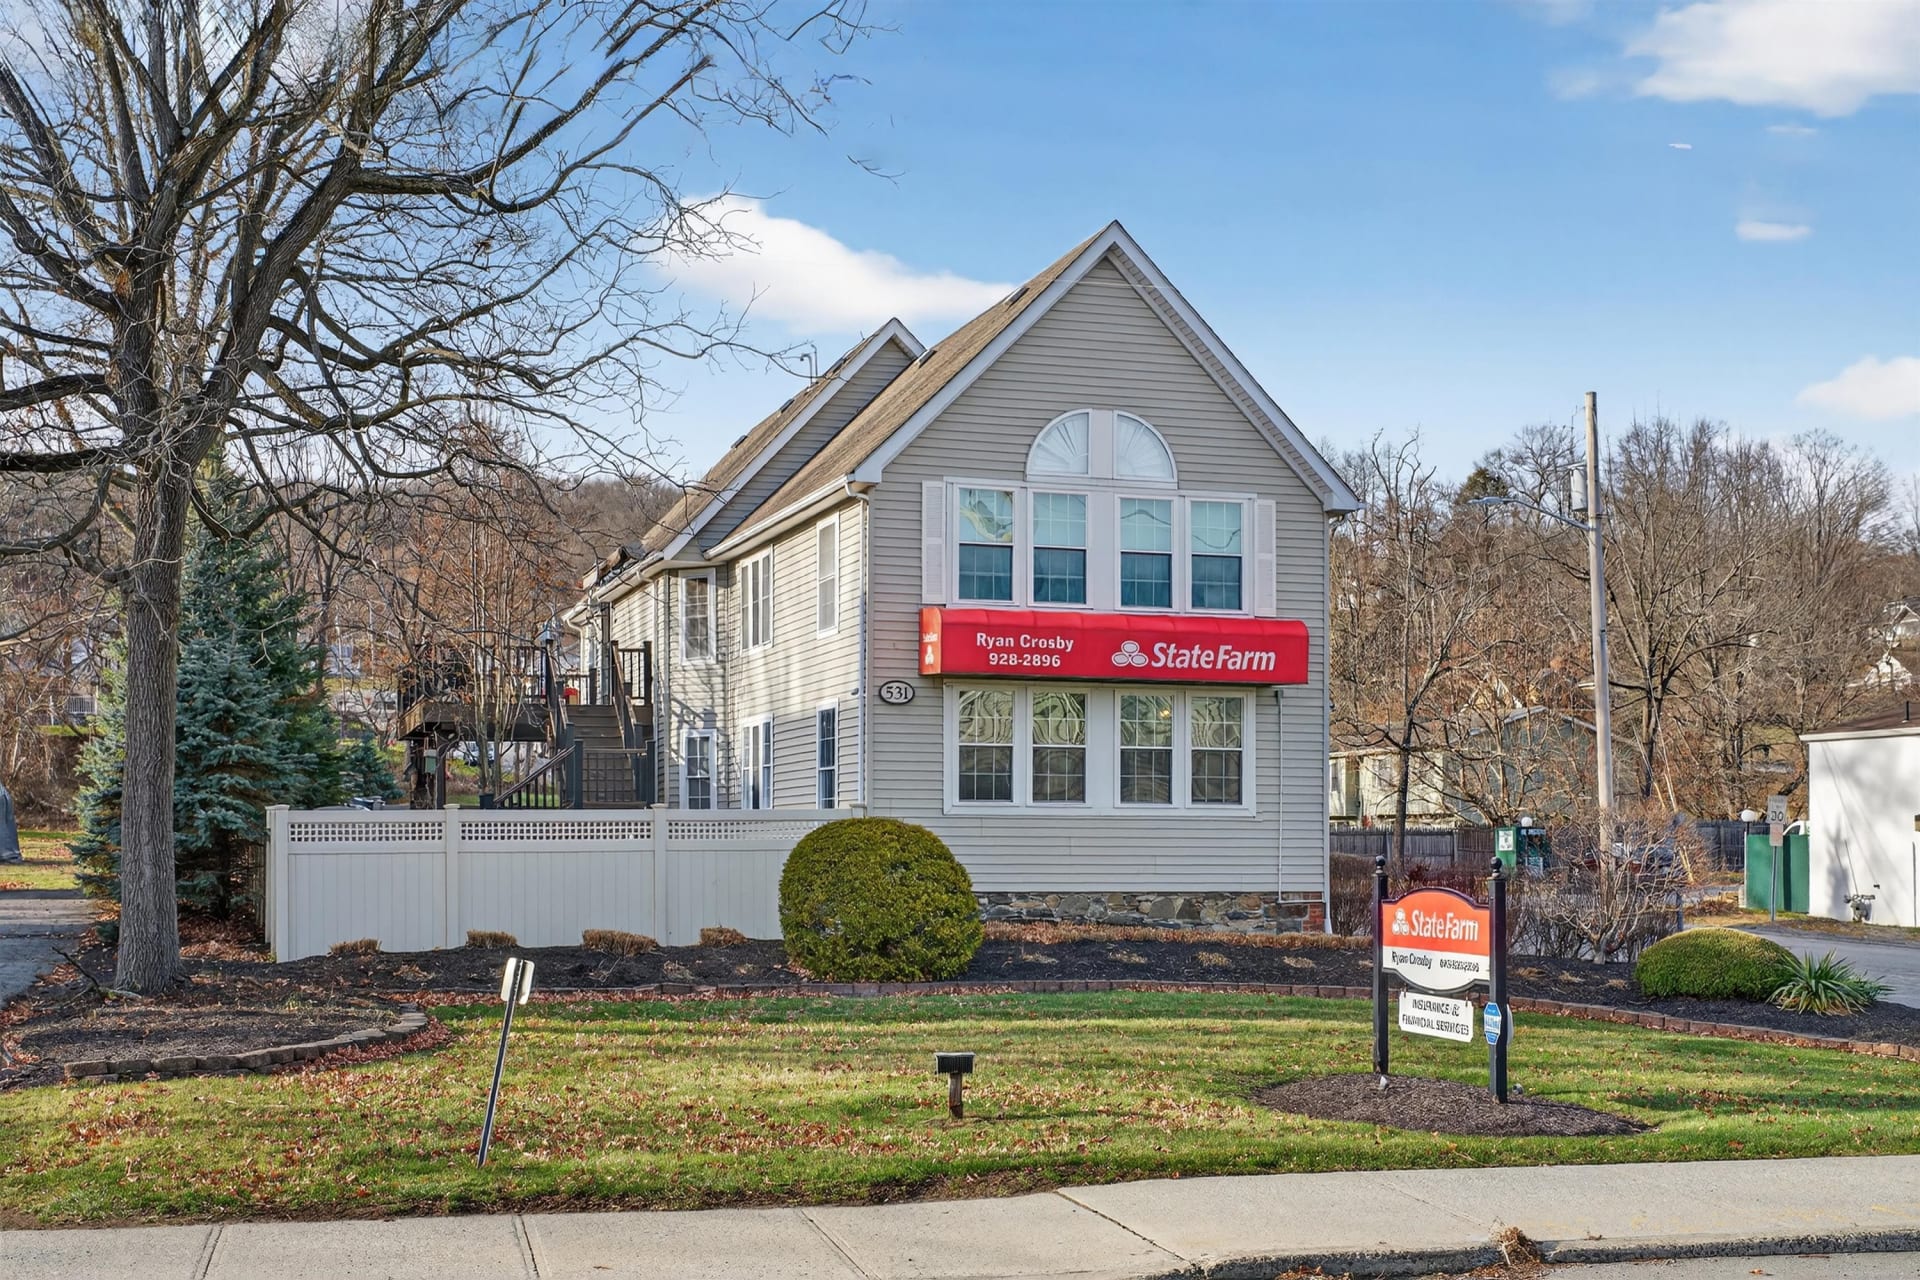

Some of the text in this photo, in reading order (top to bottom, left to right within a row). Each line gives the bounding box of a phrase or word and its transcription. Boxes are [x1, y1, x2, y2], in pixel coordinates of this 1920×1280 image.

[976, 632, 1074, 653] Ryan Crosby
[988, 652, 1061, 668] 928-2896
[886, 685, 908, 700] 531
